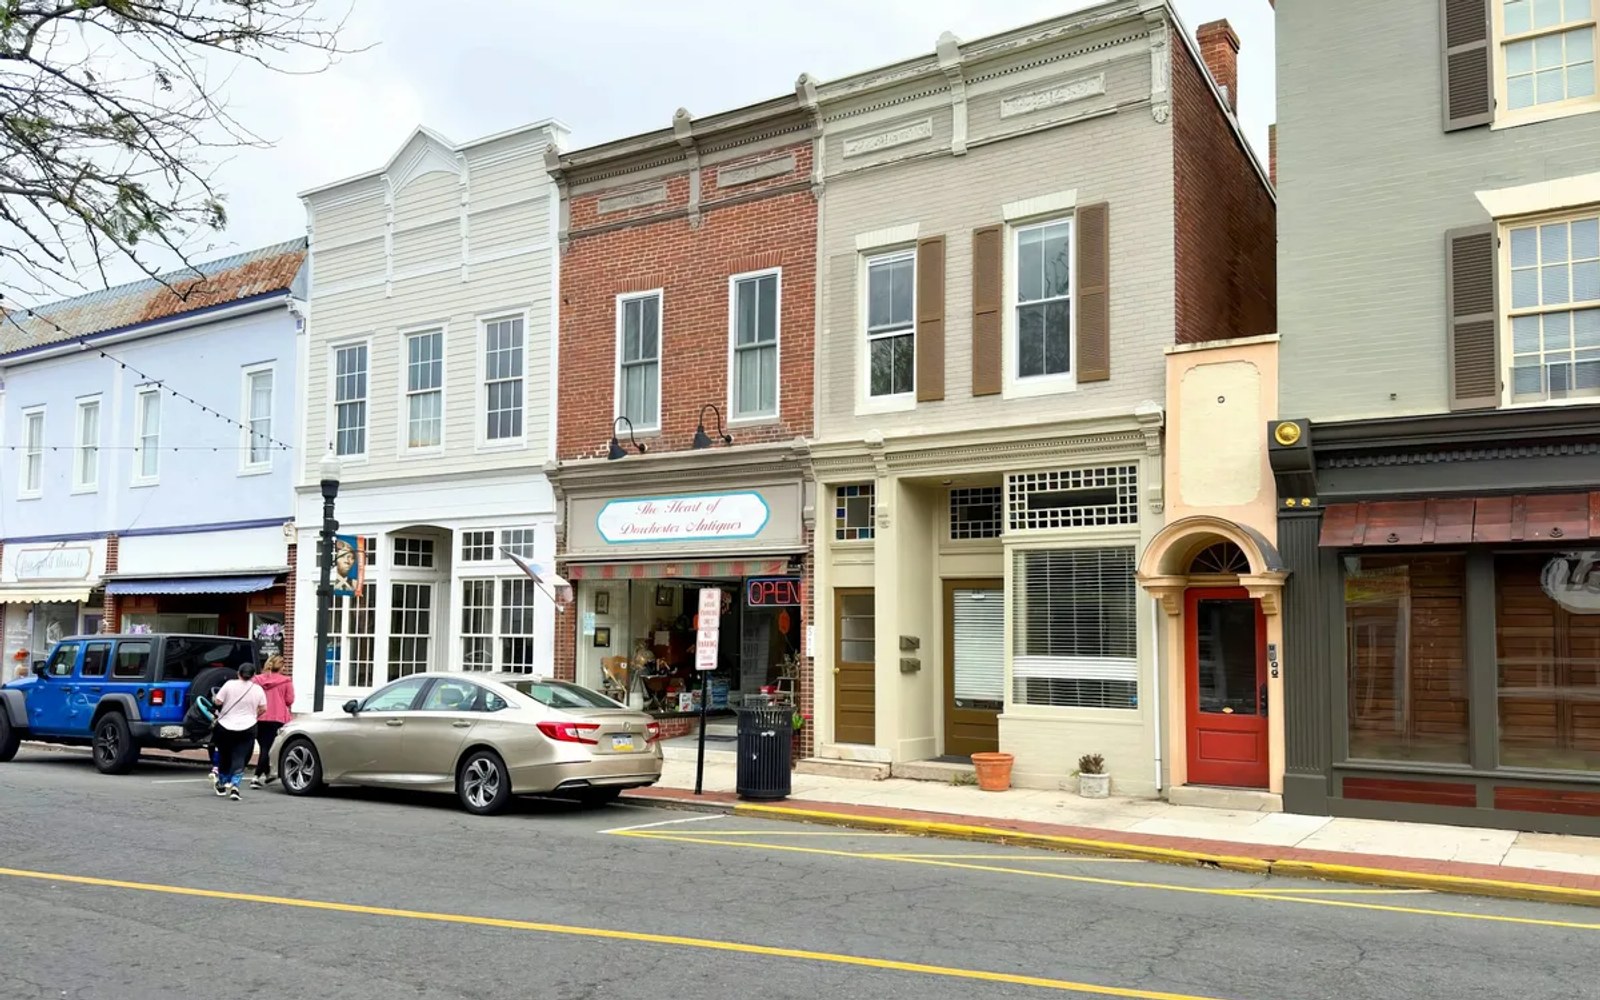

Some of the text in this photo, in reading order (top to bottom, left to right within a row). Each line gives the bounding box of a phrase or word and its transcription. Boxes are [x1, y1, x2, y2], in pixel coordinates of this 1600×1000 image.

[635, 498, 722, 515] The Heart of
[620, 518, 742, 535] Dorchester Antiques
[750, 581, 801, 604] OPEN
